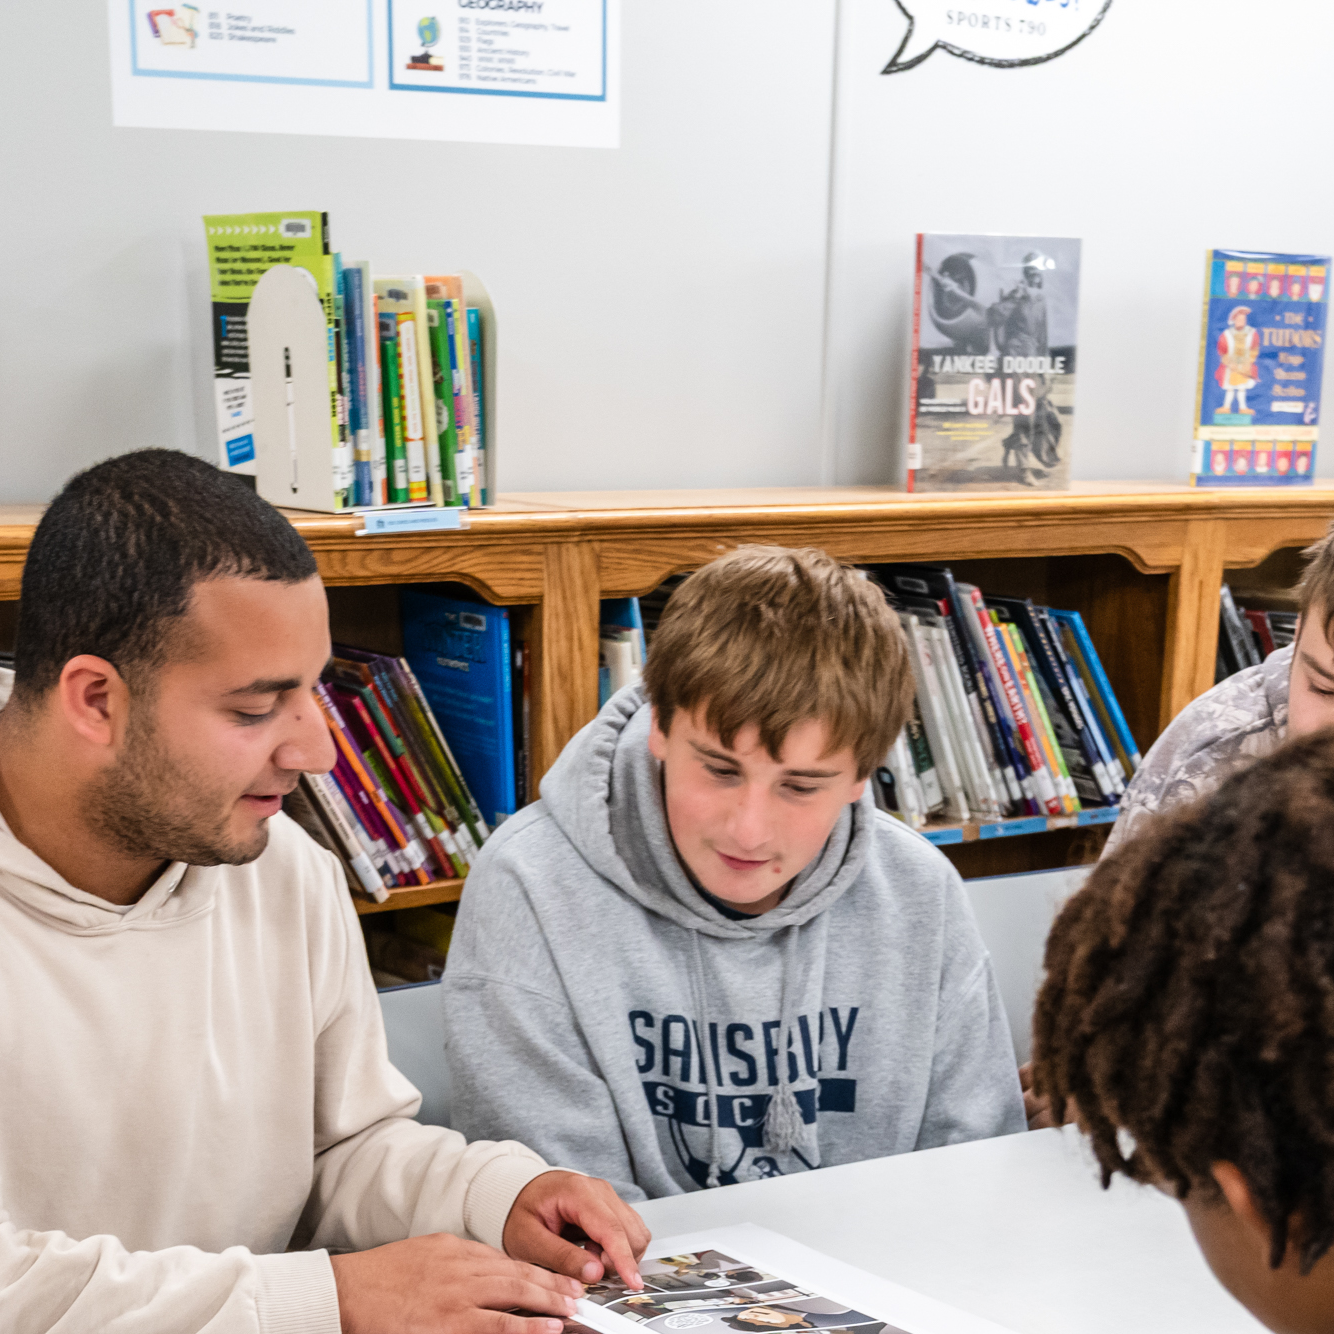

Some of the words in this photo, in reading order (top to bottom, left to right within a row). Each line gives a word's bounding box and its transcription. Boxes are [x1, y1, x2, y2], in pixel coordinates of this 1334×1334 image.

[946, 10, 1012, 32] SPORTS
[1019, 20, 1046, 36] 790
[1262, 328, 1322, 348] TUDORS
[932, 355, 995, 373] YANKEE
[1003, 356, 1066, 374] DOODLE
[968, 378, 1037, 415] GALS
[628, 1006, 859, 1087] SALISBUY
